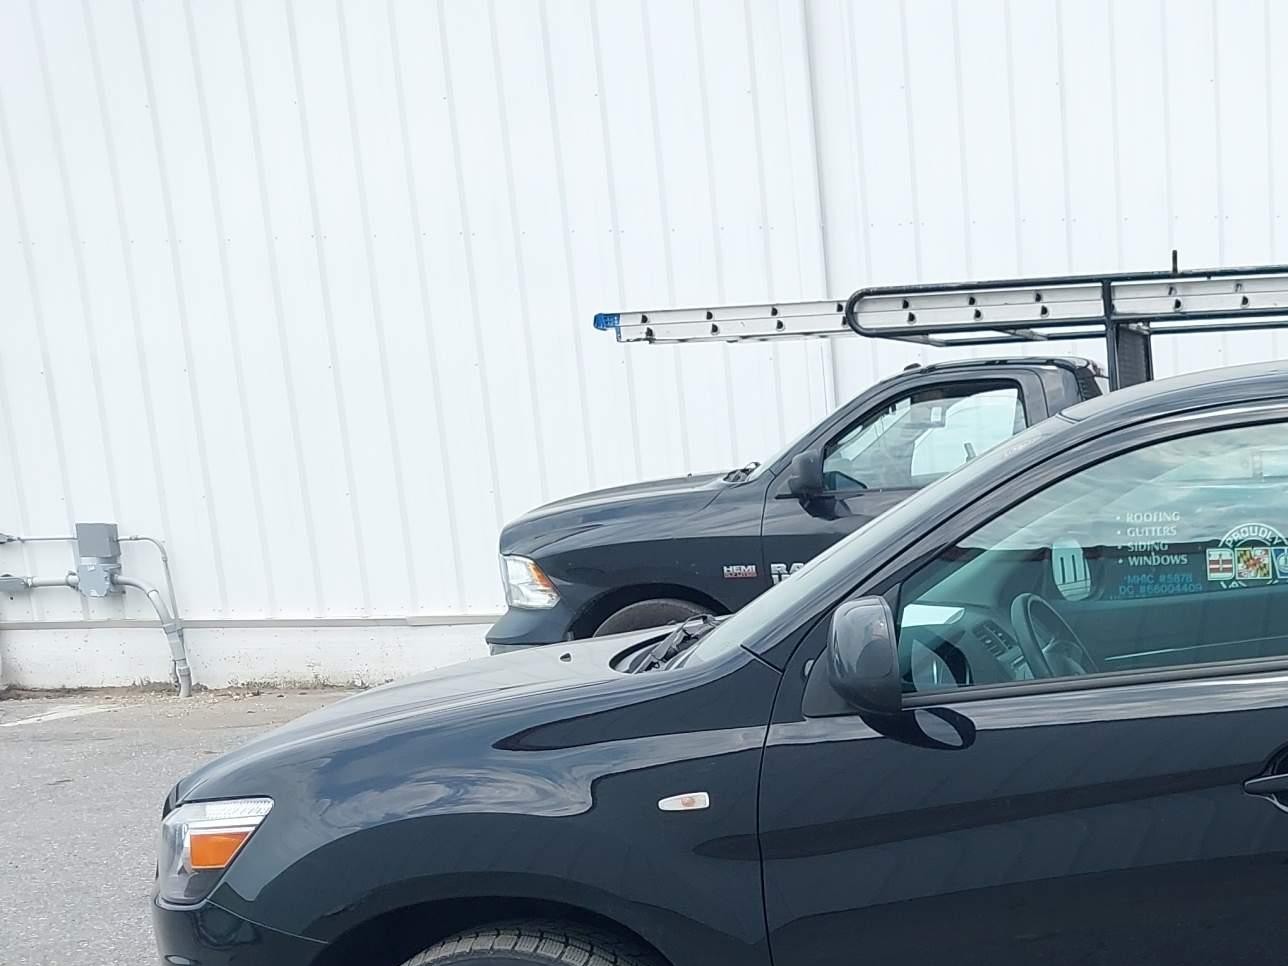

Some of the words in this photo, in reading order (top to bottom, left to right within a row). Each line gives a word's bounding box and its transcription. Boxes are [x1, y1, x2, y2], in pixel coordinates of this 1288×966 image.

[1126, 511, 1180, 523] ROOFING
[1127, 526, 1177, 537] GUTTERS
[1225, 526, 1282, 548] PROUDLY
[1127, 540, 1169, 552] SIDING
[1128, 554, 1188, 566] WINDOWS
[723, 565, 756, 573] HEMI
[770, 562, 806, 574] RA
